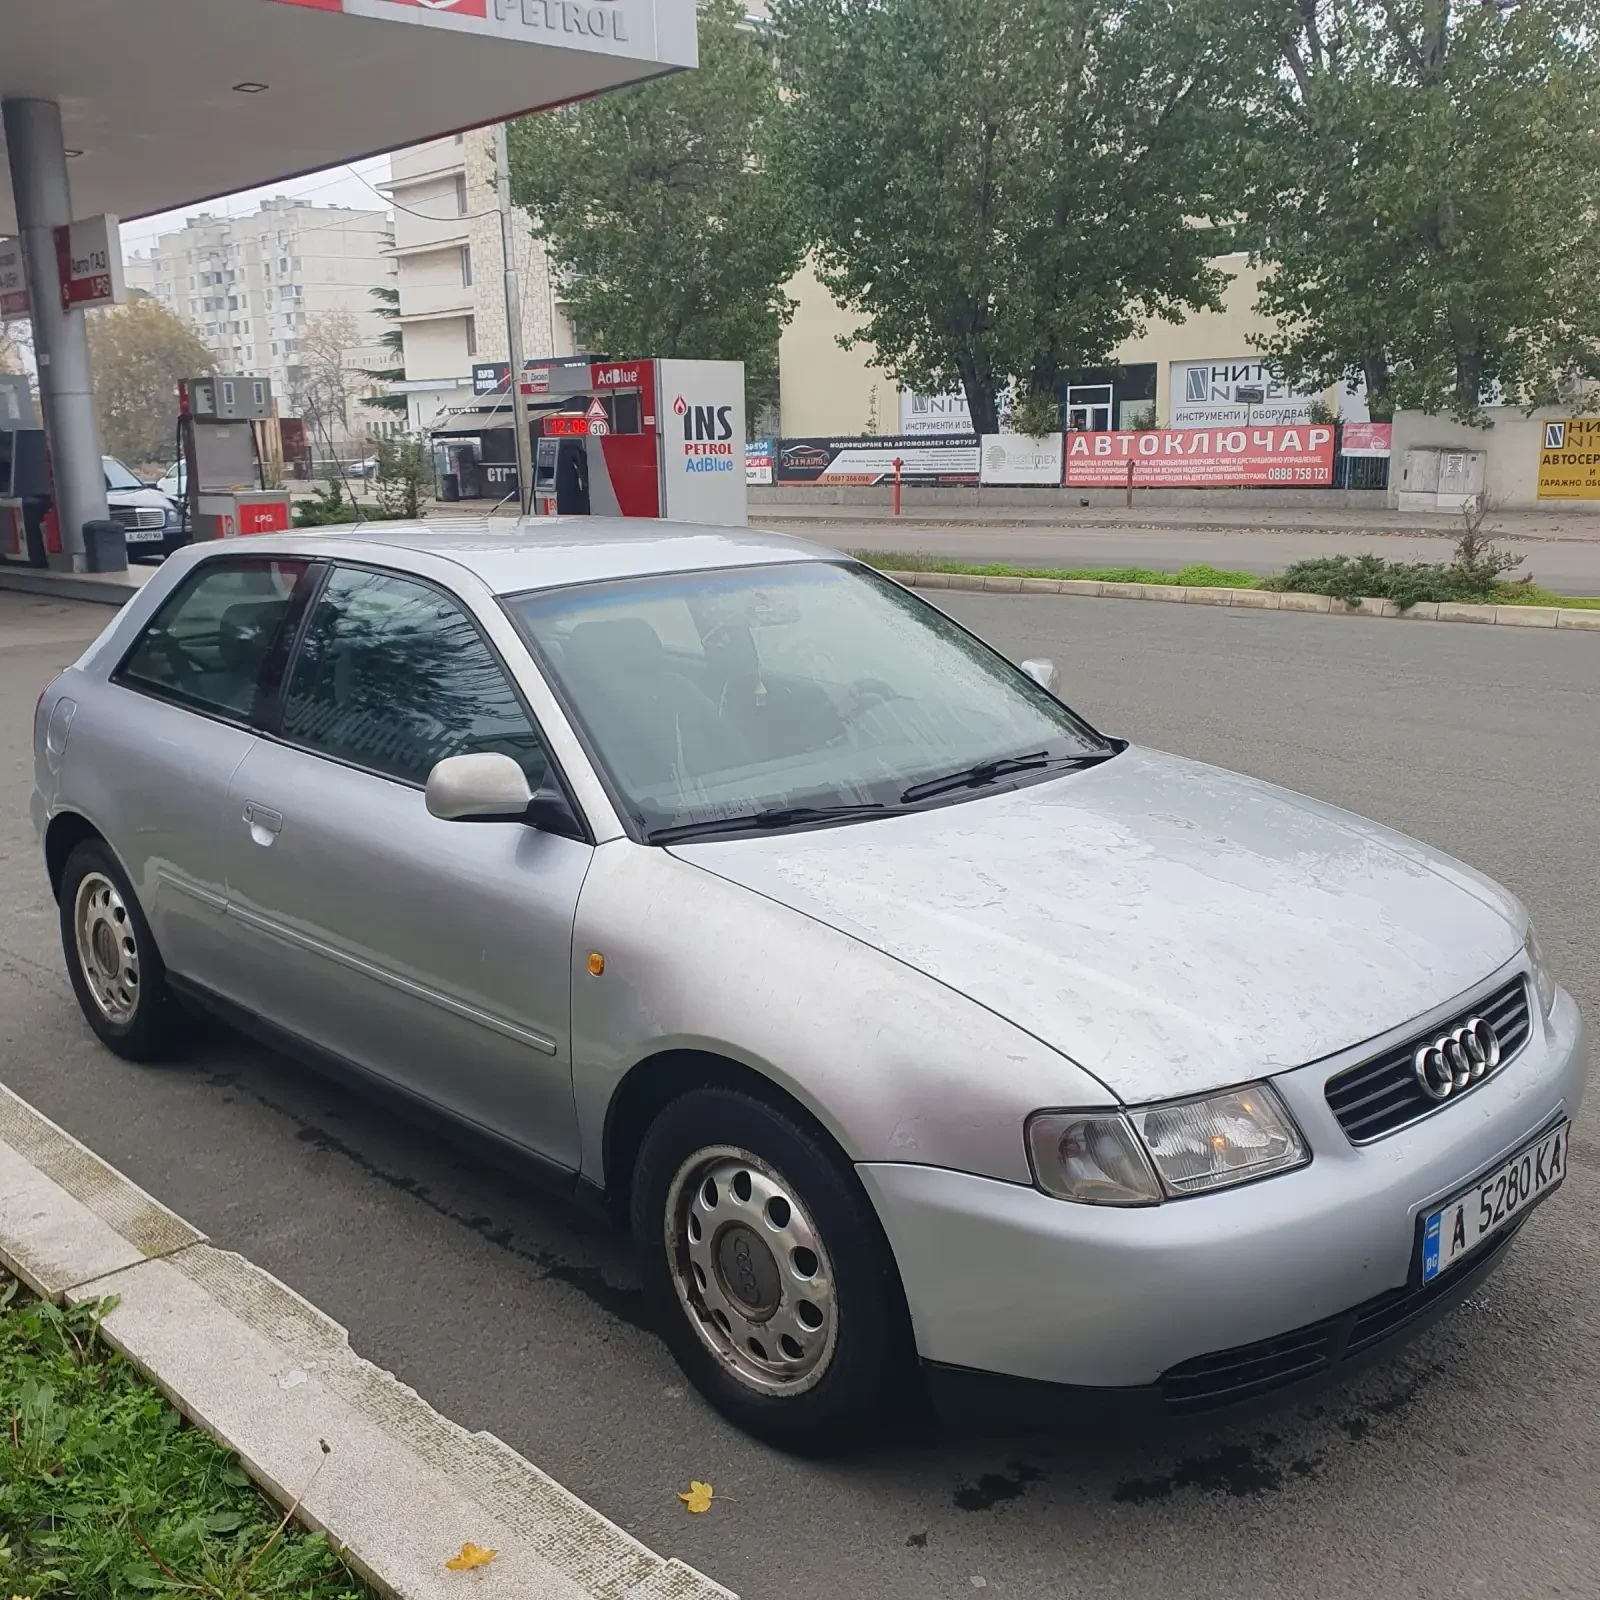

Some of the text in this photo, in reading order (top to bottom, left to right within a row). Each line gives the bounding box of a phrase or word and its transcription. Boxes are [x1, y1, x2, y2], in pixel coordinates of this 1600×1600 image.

[494, 0, 629, 41] PETROL
[90, 251, 106, 269] ГАЗ
[597, 368, 638, 385] AdBlue
[1212, 365, 1285, 382] НИТЕ
[931, 398, 969, 413] NIT
[684, 405, 733, 441] INS
[1175, 411, 1241, 422] ИНСТРУМЕНТИ
[1252, 409, 1311, 419] ОБОРУДВАН
[551, 420, 587, 433] 12:09
[592, 423, 604, 434] 30
[905, 420, 953, 431] ИНСТРУМЕНТИ
[955, 420, 961, 429] И
[684, 443, 733, 455] PETROL
[830, 441, 882, 449] МОДИФИЦИРАНЕ
[884, 440, 893, 448] НА
[894, 439, 944, 447] АВТОМОБИЛЕН
[1069, 429, 1331, 456] АВТОКЛЮЧАР
[685, 457, 734, 472] AdBlue
[1268, 467, 1329, 480] 0888 758 121
[1540, 479, 1582, 487] ГАРАЖНО
[254, 515, 273, 523] LPG
[1451, 1134, 1561, 1256] A 5280 KA
[1426, 1253, 1438, 1273] BG
